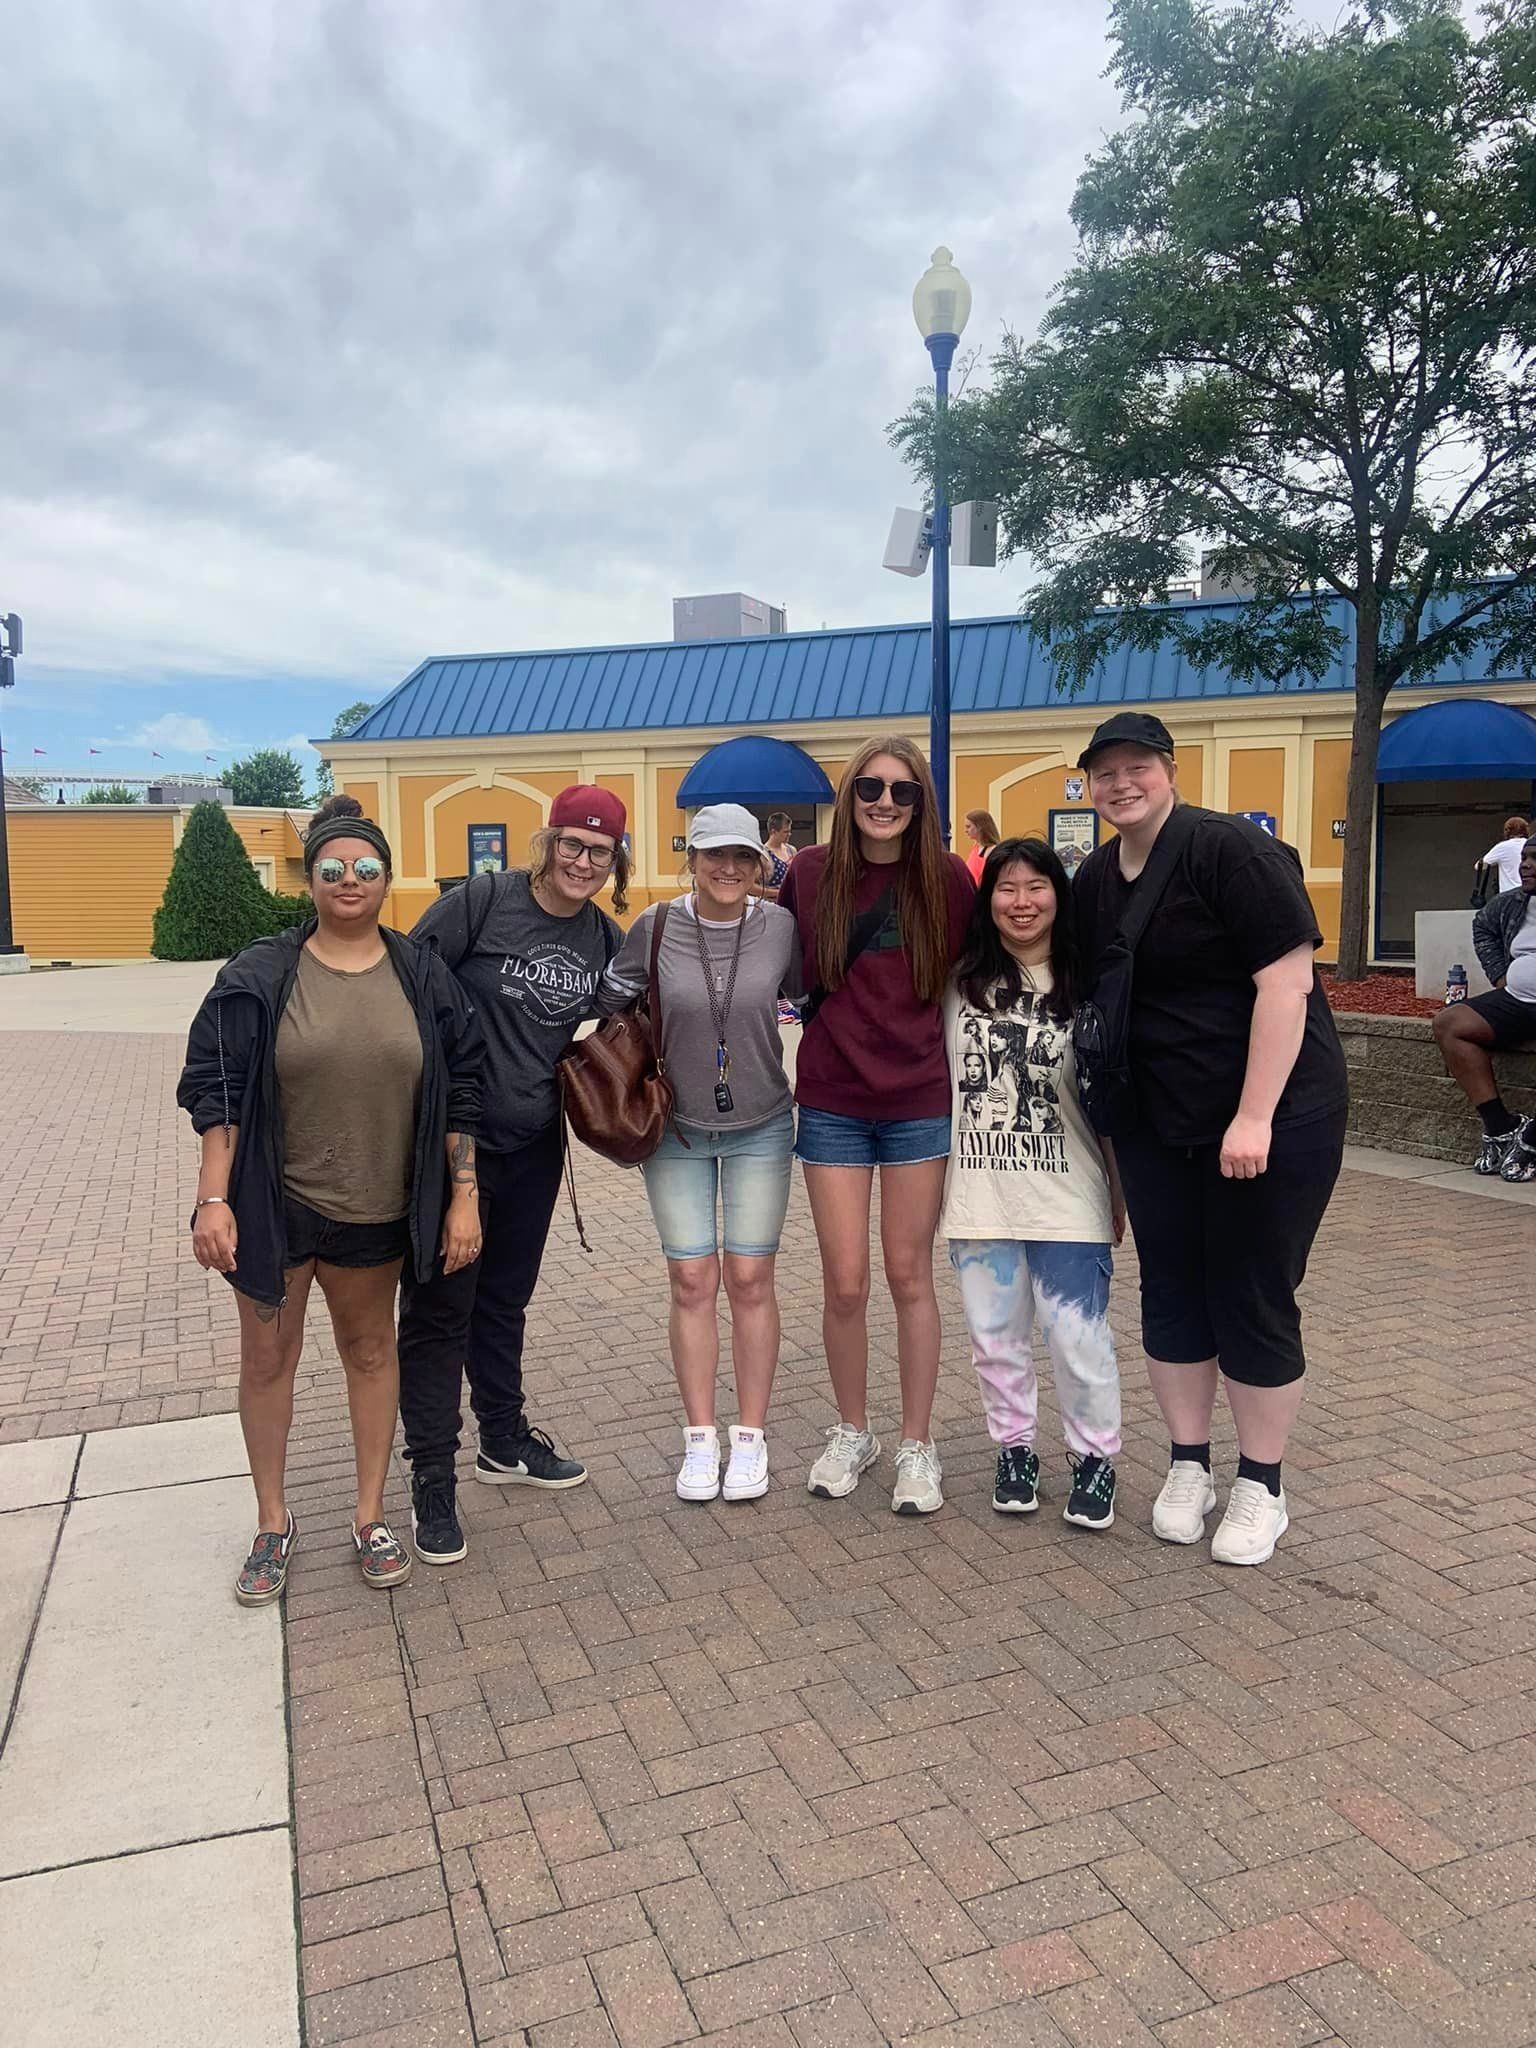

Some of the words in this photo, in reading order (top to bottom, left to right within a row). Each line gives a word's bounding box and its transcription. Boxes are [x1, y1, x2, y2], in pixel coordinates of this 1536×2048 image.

[958, 1131, 1017, 1158] TAYLOR
[958, 1156, 985, 1170] THE
[990, 1157, 1028, 1172] ERAS
[1031, 1160, 1070, 1173] TOUR
